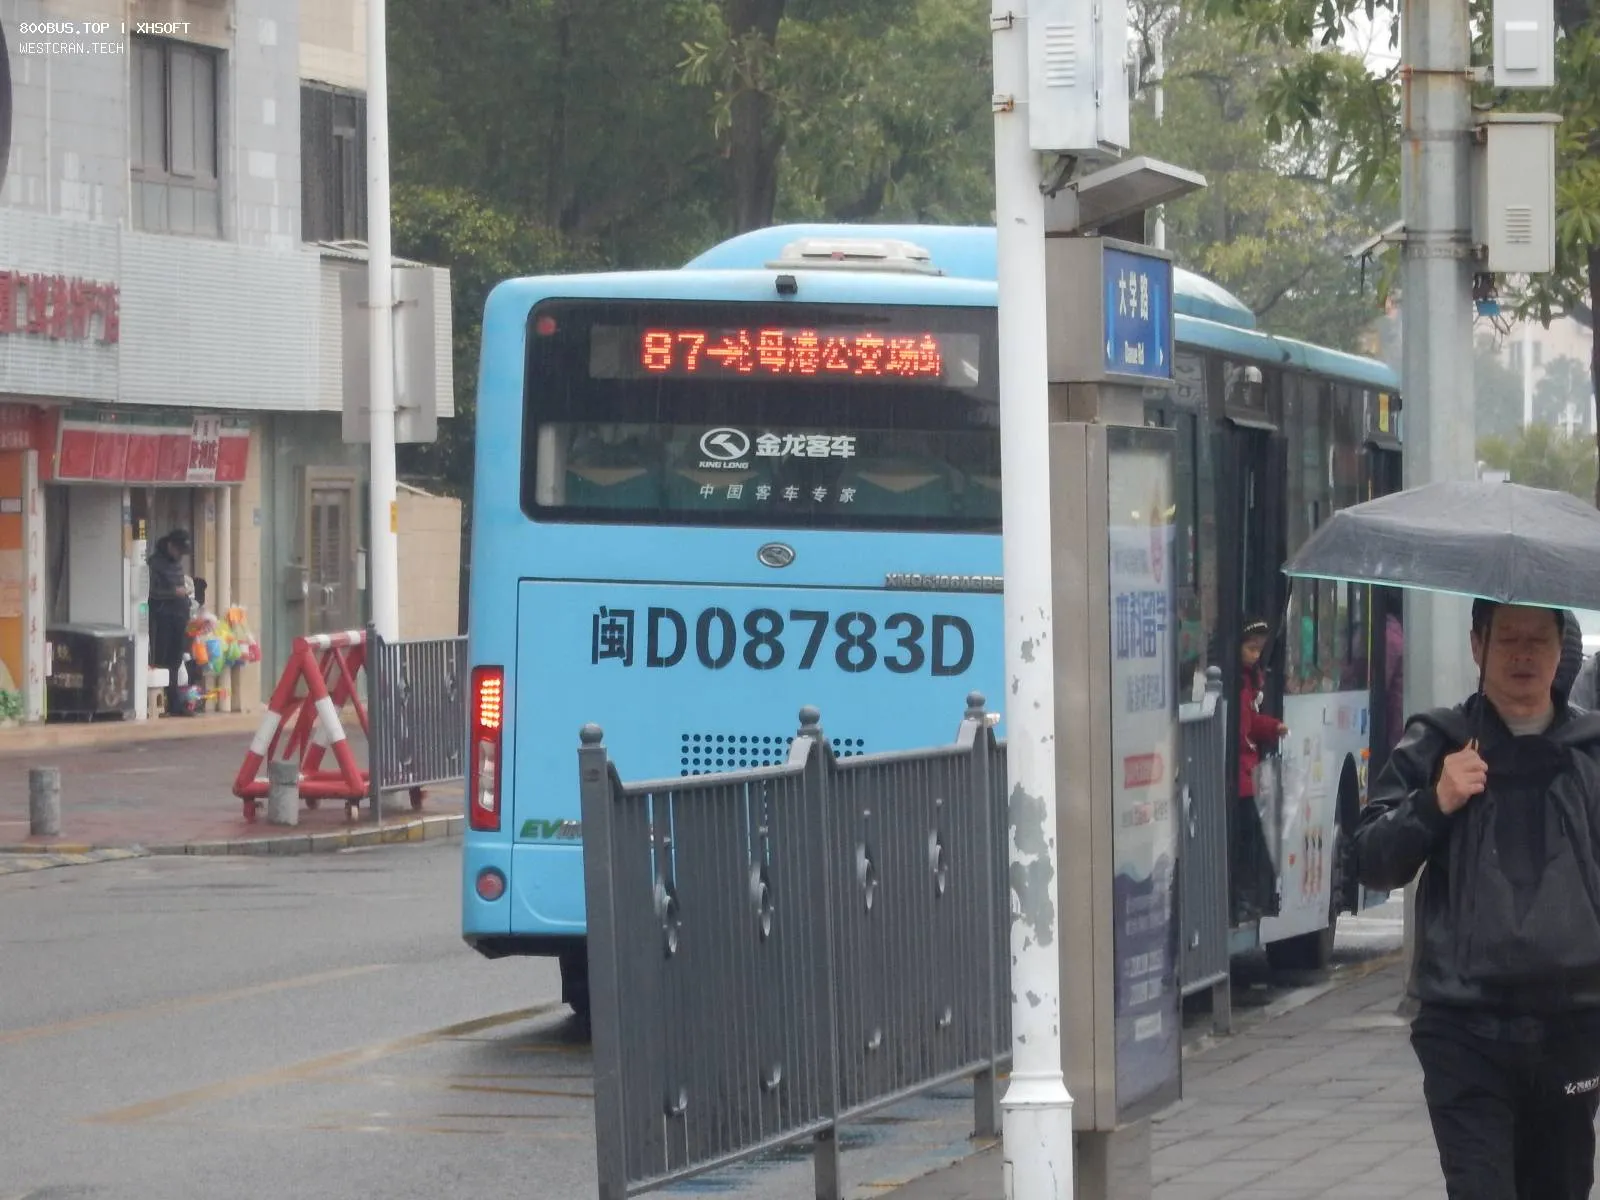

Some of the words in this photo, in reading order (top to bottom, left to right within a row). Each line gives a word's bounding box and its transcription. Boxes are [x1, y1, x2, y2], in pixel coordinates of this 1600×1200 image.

[1119, 268, 1149, 321] 大学路
[643, 331, 705, 370] 87
[755, 432, 856, 459] 金龙客车
[699, 461, 722, 469] KING
[723, 462, 749, 470] LONG
[699, 483, 857, 503] 中国客车专家
[591, 605, 975, 677] 闽D08783D
